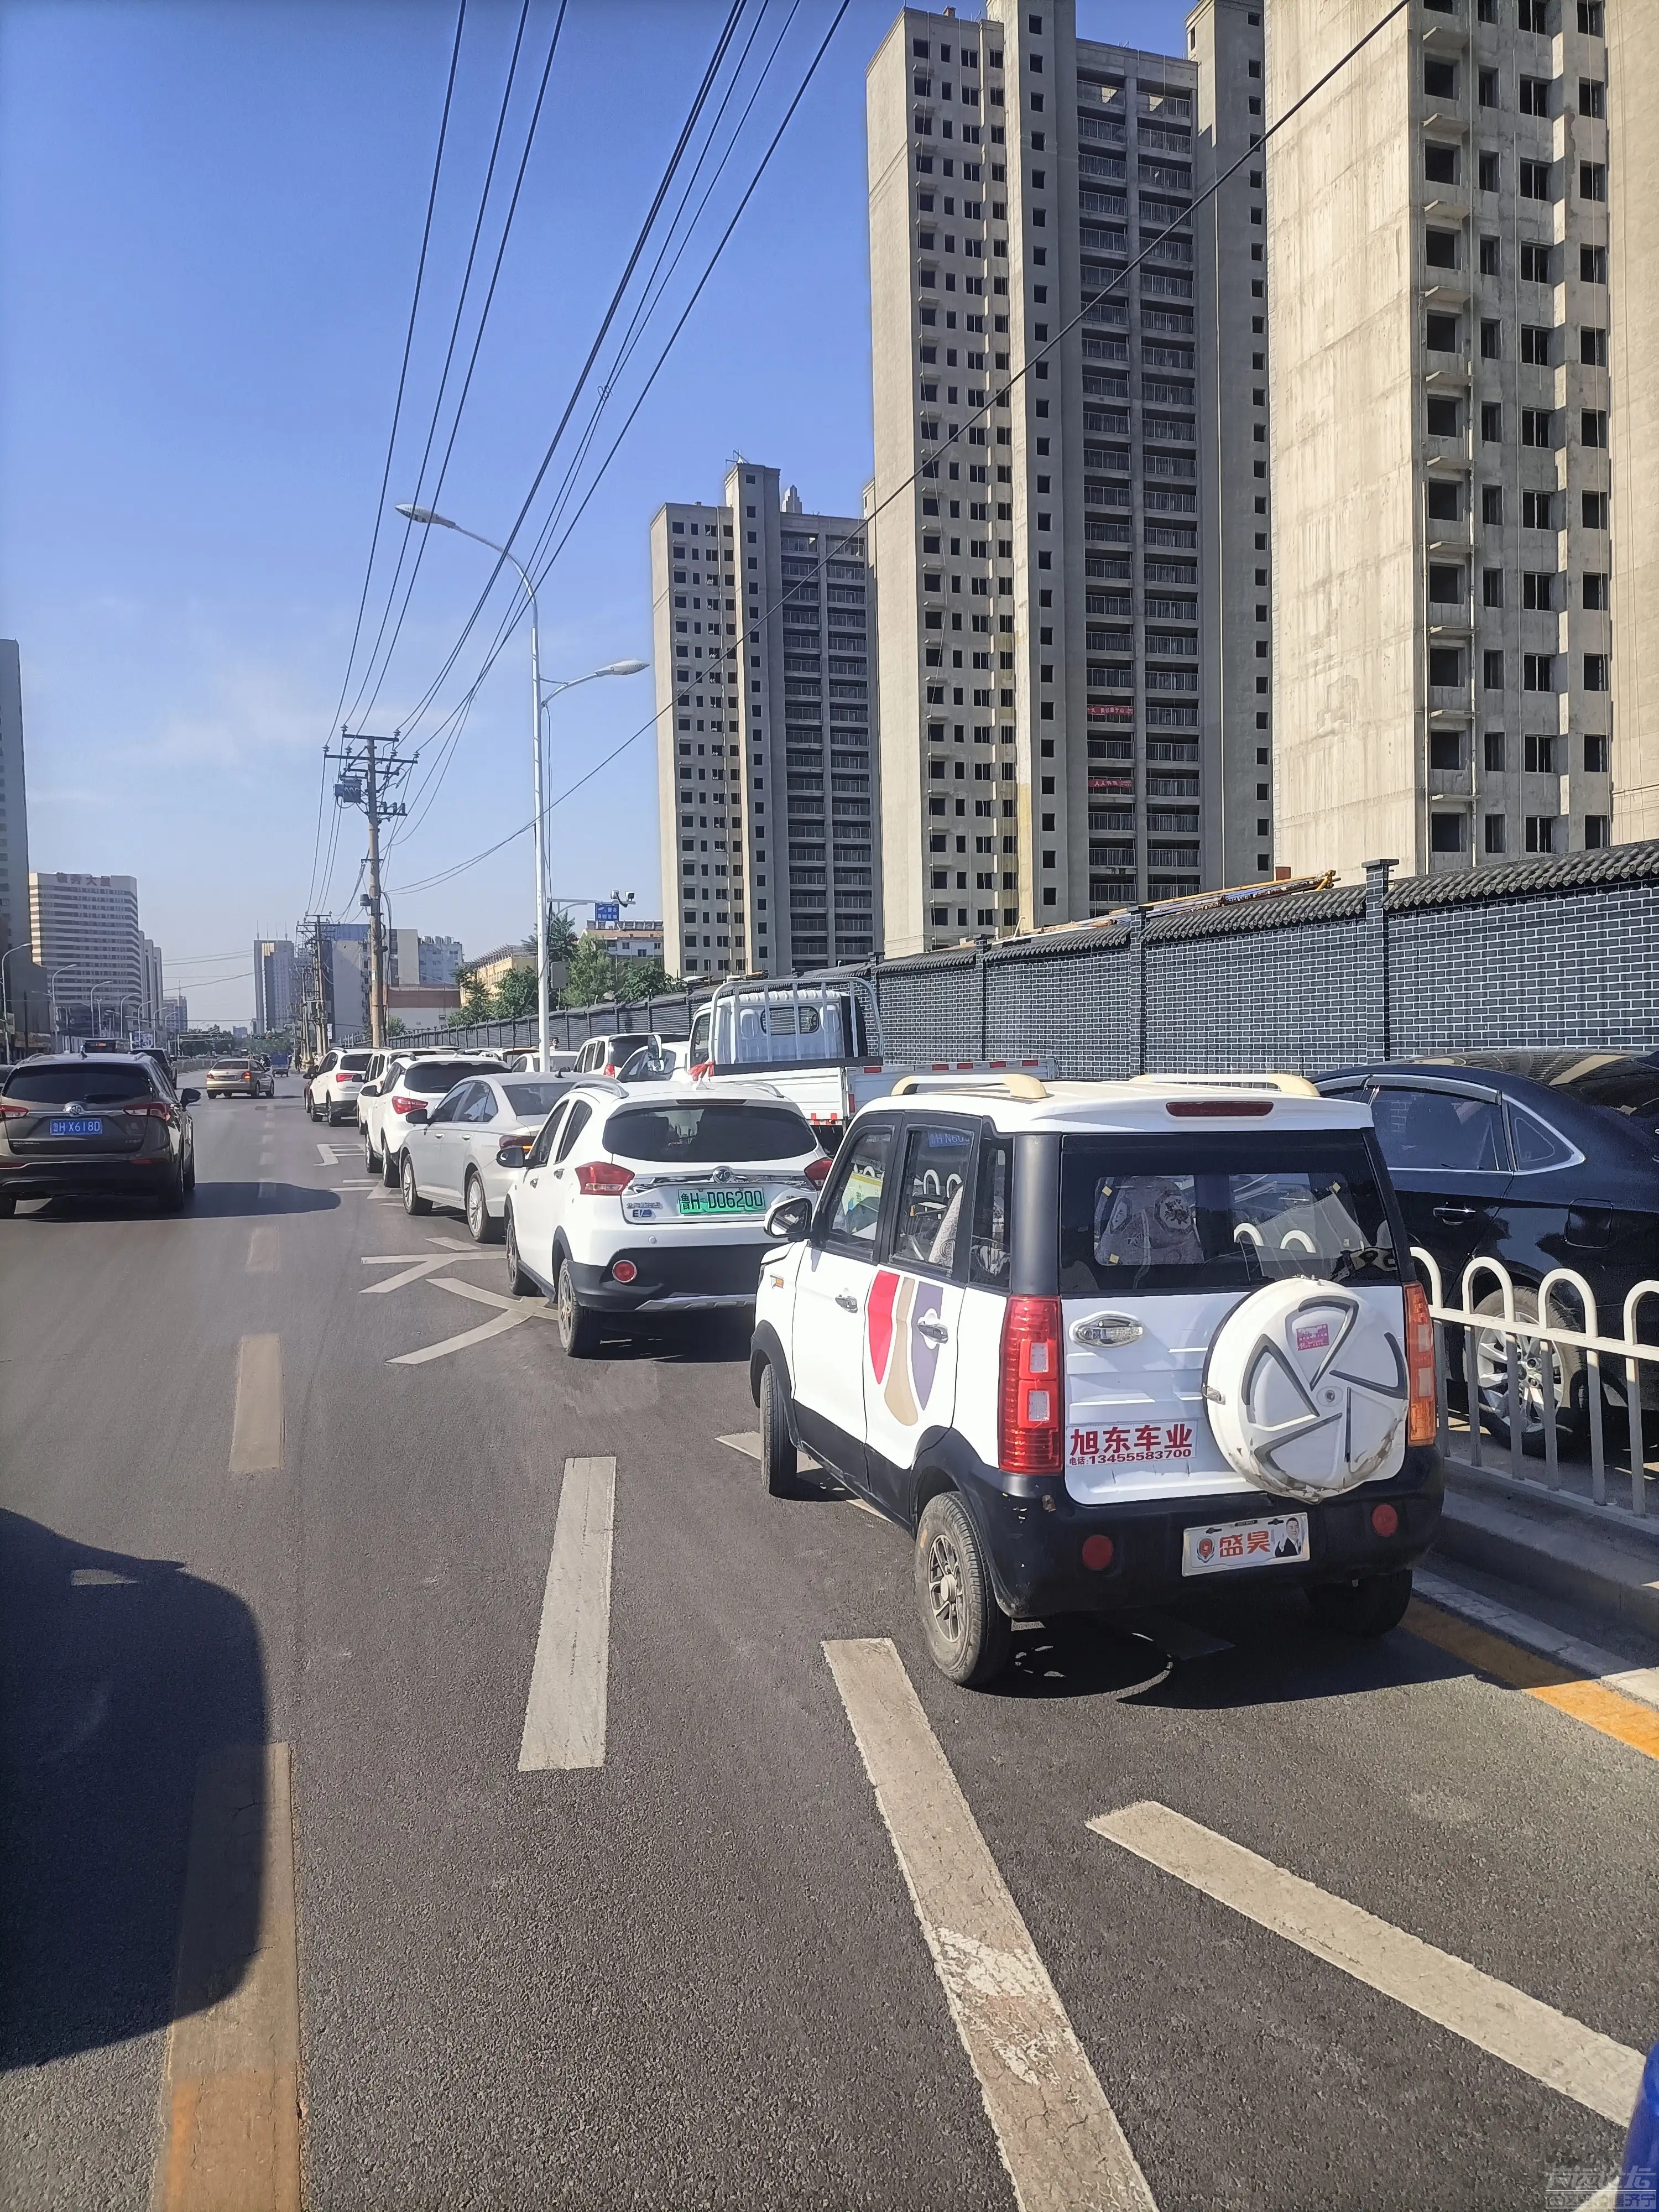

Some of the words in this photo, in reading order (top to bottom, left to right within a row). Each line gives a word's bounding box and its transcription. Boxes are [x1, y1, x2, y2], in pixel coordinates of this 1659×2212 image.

[1070, 1423, 1193, 1456] 旭东车业
[1219, 1530, 1271, 1558] 盛昊
